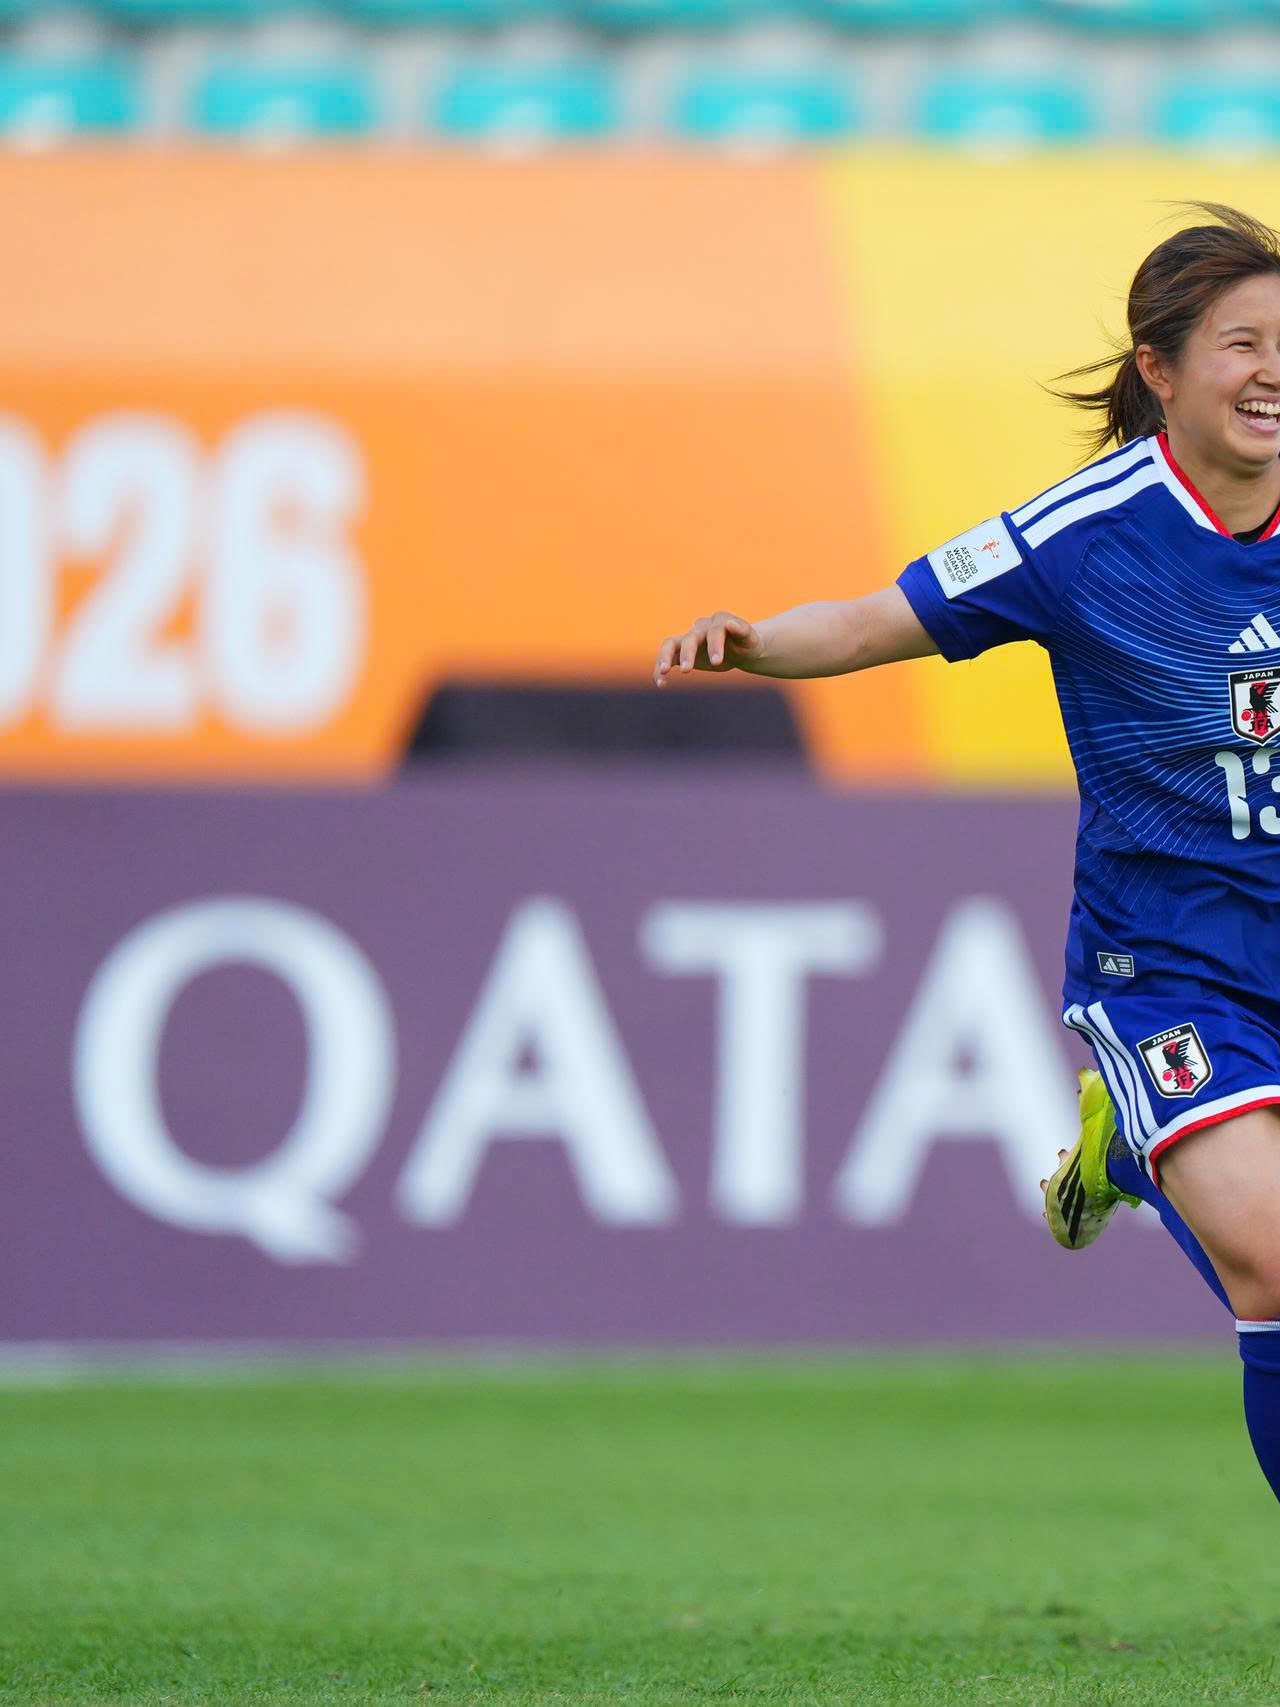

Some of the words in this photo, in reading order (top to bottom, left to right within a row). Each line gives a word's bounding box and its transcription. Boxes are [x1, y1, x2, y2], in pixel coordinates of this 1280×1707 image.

[945, 550, 959, 571] ASIAN
[955, 570, 966, 583] CUP
[960, 547, 971, 560] AFC
[968, 560, 978, 574] U20
[1243, 671, 1274, 680] JAPAN
[1248, 718, 1274, 732] JFA
[1152, 1029, 1181, 1046] JAPAN
[72, 894, 1160, 1265] QATA
[1174, 1072, 1198, 1090] JFA
